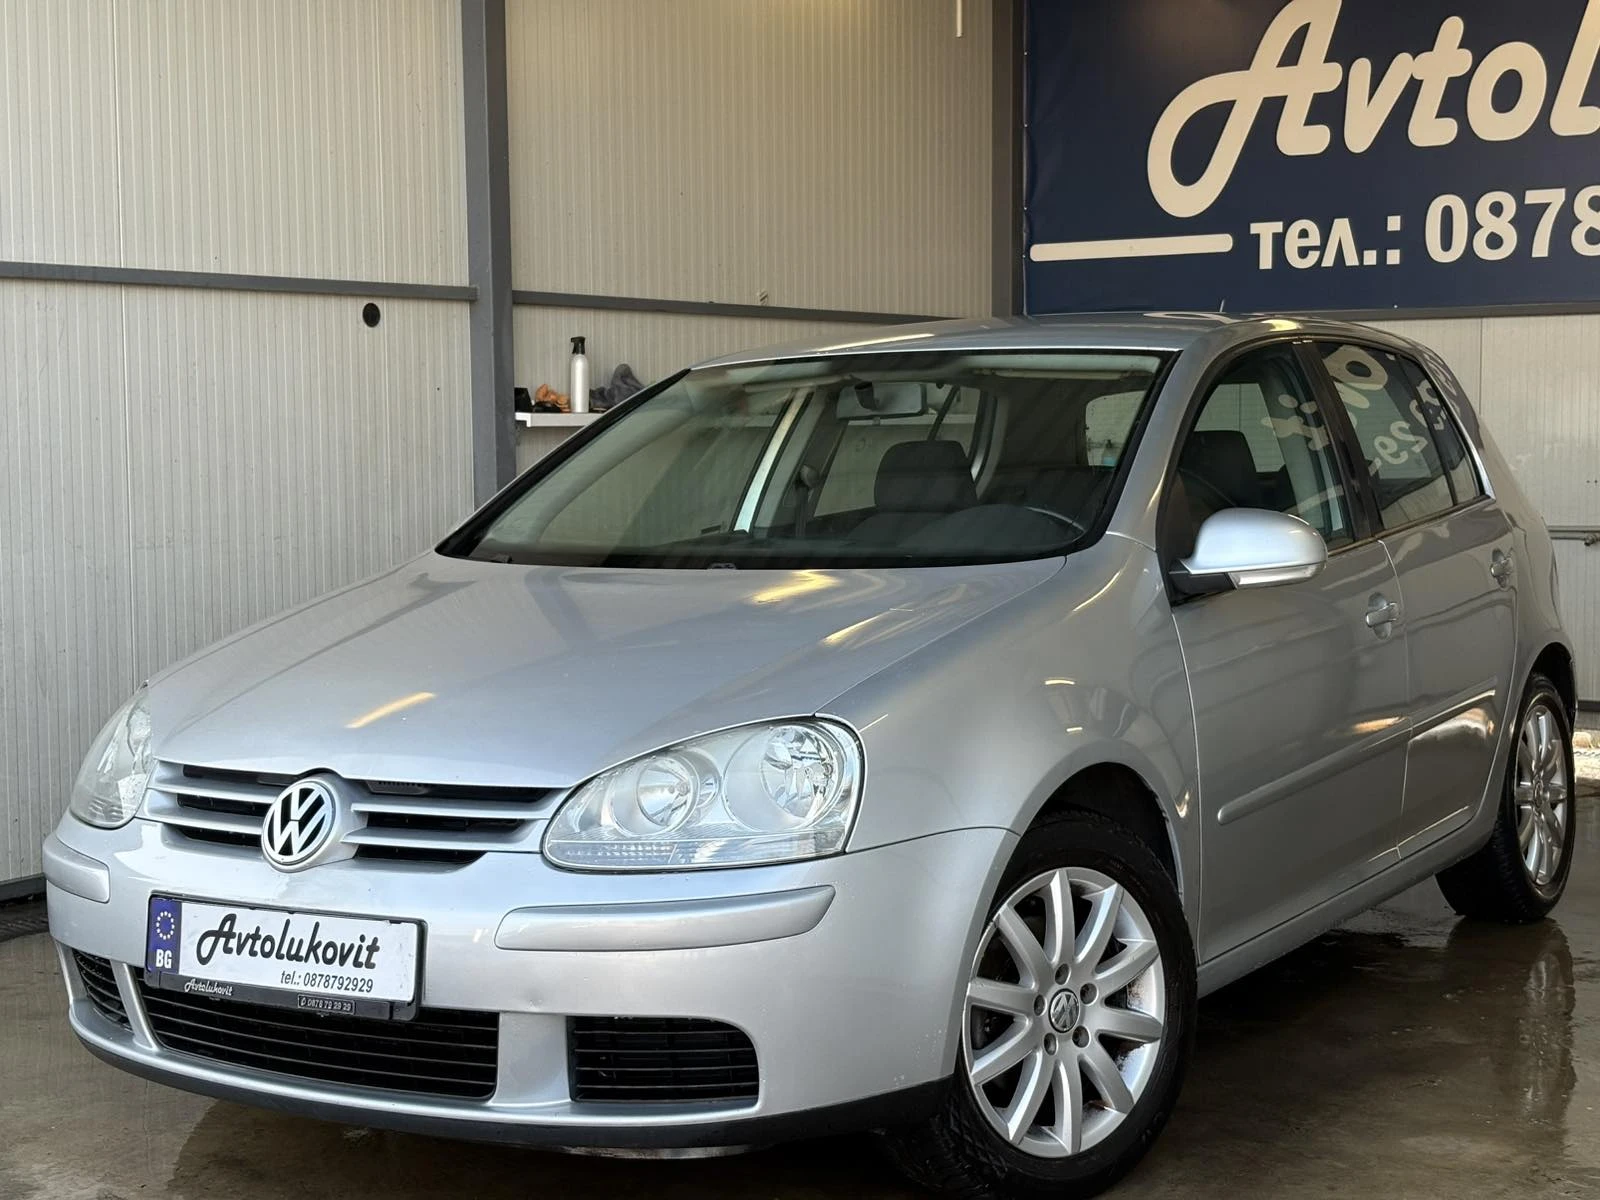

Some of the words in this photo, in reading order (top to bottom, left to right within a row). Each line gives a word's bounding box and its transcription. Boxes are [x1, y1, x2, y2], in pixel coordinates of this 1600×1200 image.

[196, 913, 380, 970] Avtolukovit
[155, 949, 172, 968] BG
[184, 978, 234, 997] Avtolukovit
[280, 970, 302, 987] tel.:
[303, 973, 374, 993] 0878792929
